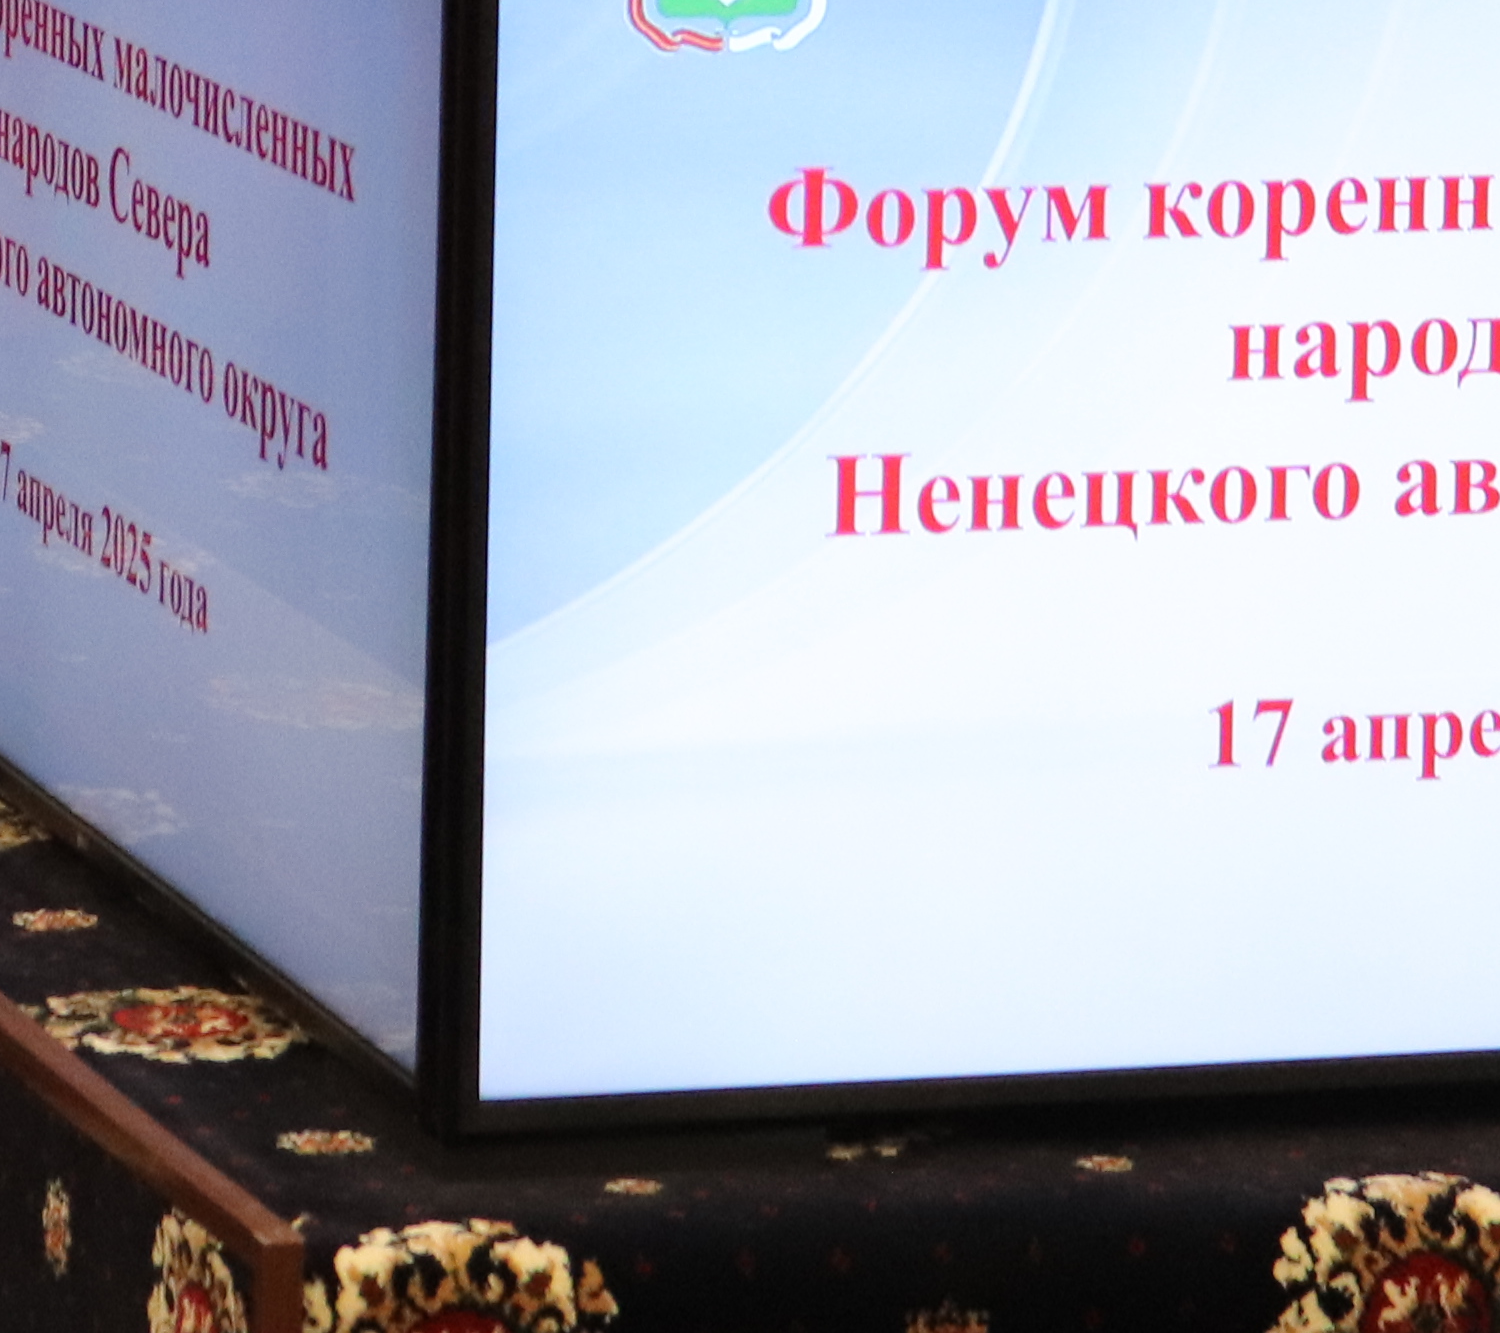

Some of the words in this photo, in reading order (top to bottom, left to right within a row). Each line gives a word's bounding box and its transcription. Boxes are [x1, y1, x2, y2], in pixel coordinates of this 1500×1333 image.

[114, 33, 355, 201] малочисленных
[109, 147, 210, 279] Севера
[767, 167, 1110, 270] Форум
[37, 254, 213, 402] автономного
[224, 361, 328, 470] округа
[18, 468, 93, 557] апреля
[100, 505, 151, 595] 2025
[158, 561, 208, 634] года
[829, 453, 1360, 543] Ненецкого
[1211, 699, 1294, 770] 17
